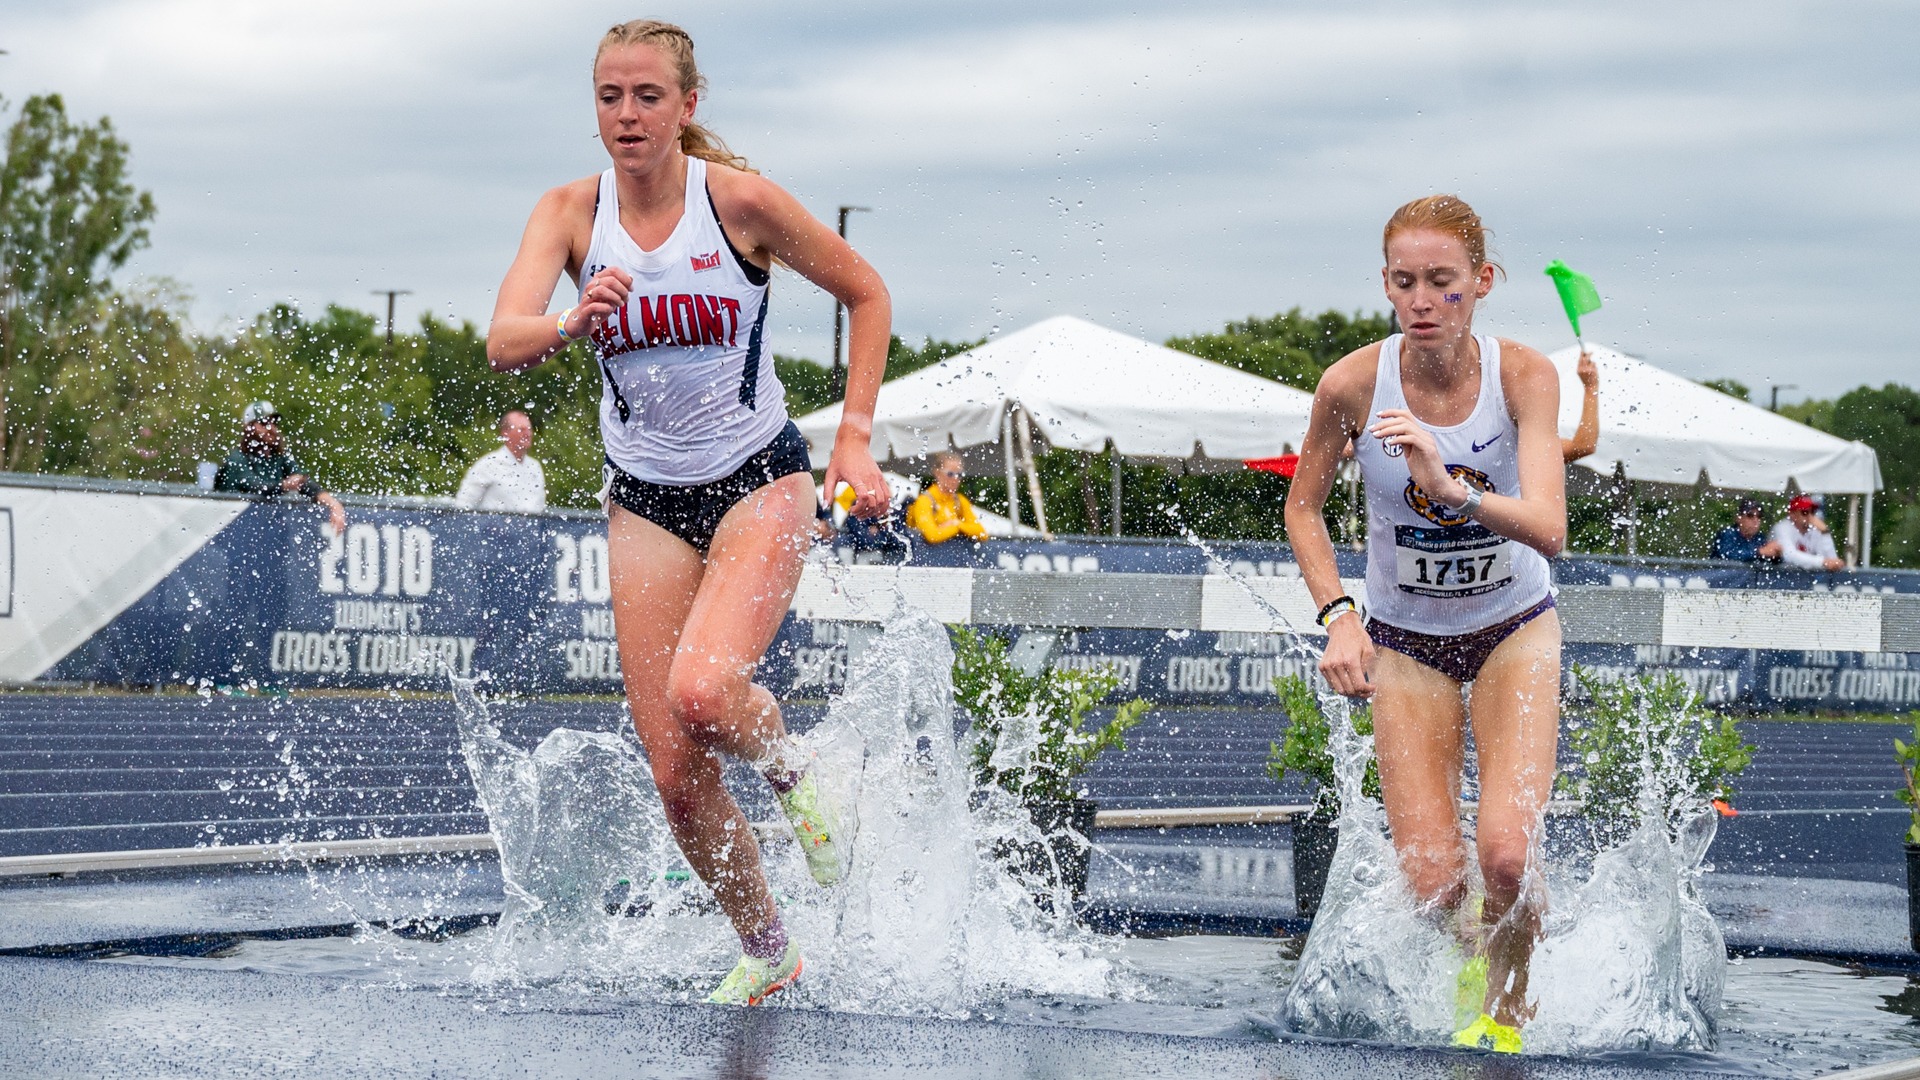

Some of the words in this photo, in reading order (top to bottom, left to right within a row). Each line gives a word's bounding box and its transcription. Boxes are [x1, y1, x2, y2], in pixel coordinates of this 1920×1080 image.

[320, 522, 433, 596] 2010
[1415, 541, 1433, 549] TRACK
[1440, 540, 1456, 549] FIELD
[555, 533, 611, 603] 20
[1415, 553, 1496, 586] 1757
[336, 601, 423, 631] WOMEN'S
[270, 631, 351, 673] CROSS
[358, 634, 477, 679] COUNTRY
[1167, 655, 1232, 693] CROSS
[1769, 666, 1834, 698] CROSS
[1838, 669, 1920, 702] COUNTR
